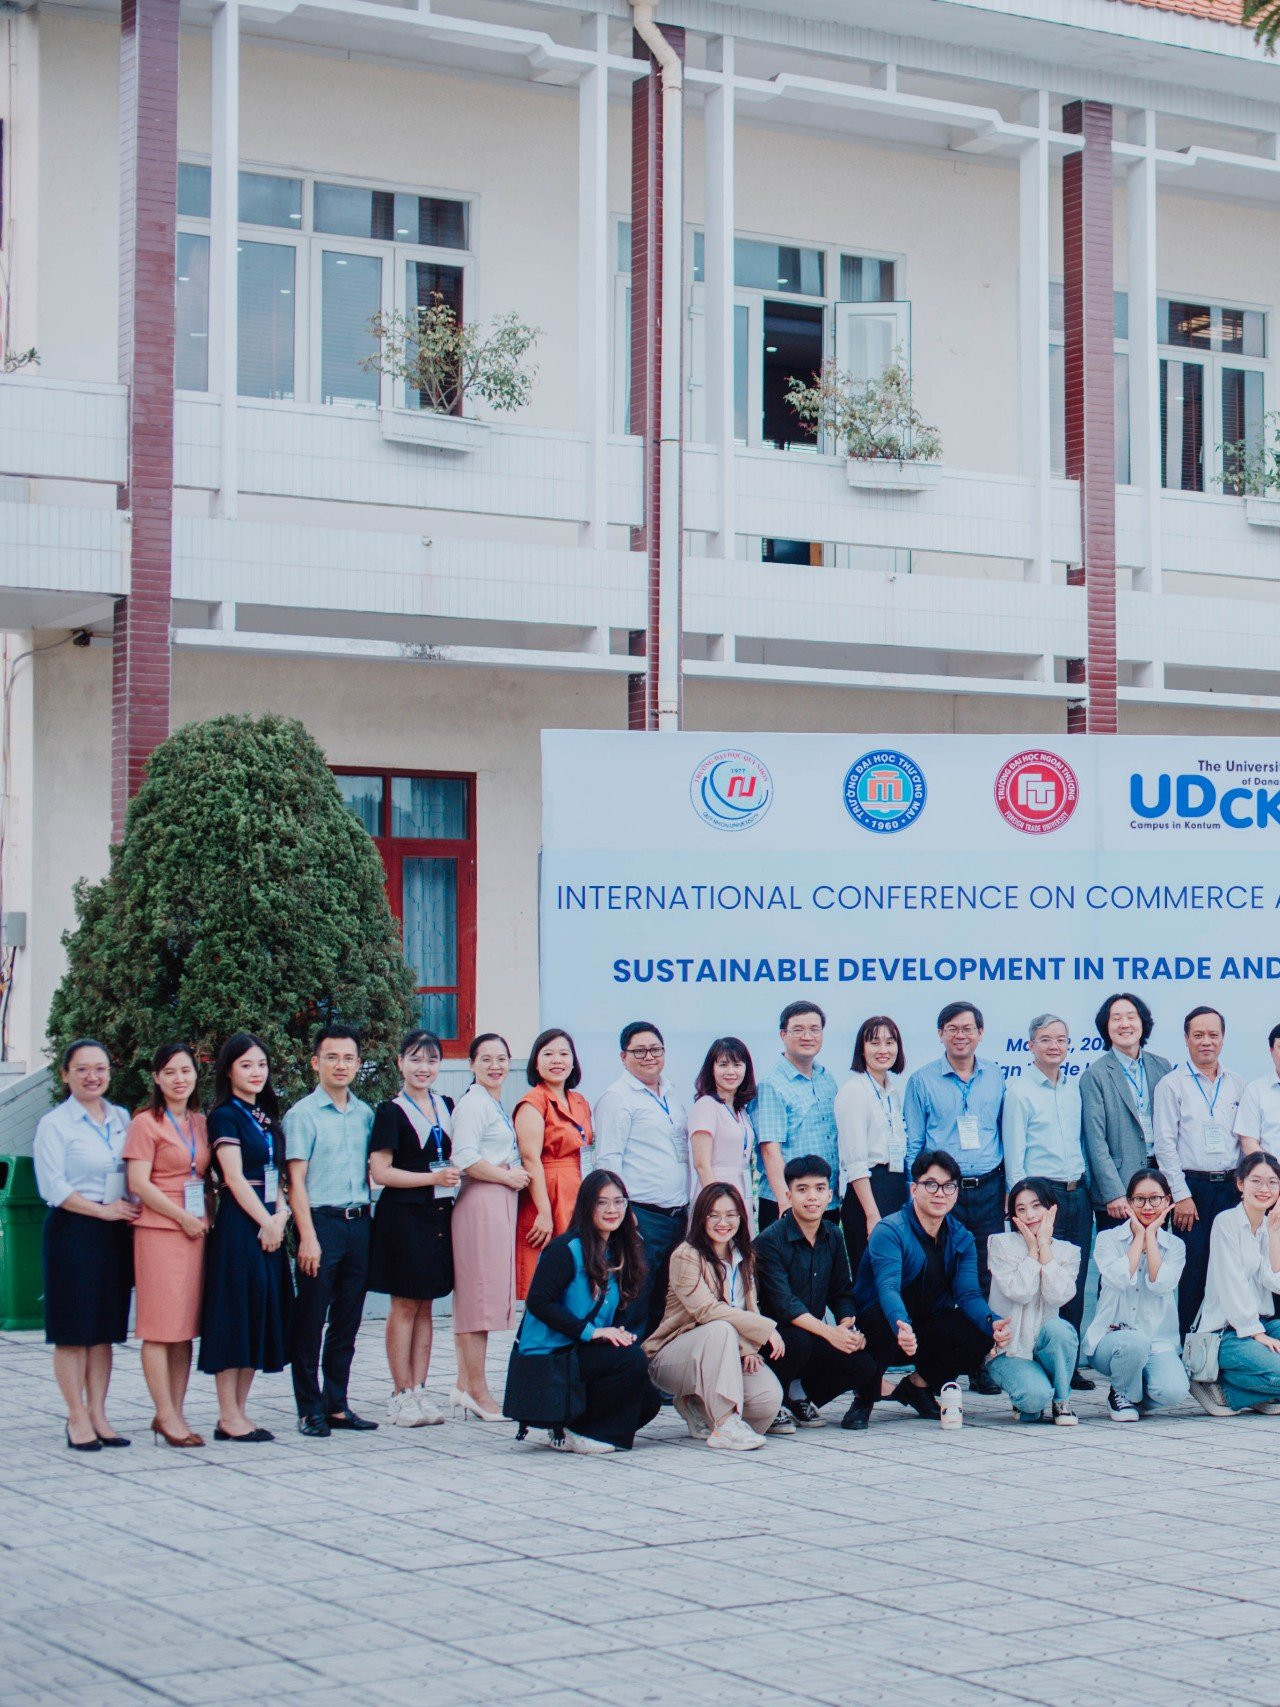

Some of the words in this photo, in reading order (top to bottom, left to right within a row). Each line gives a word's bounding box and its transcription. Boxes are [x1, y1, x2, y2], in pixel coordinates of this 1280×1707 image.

[855, 758, 872, 775] ĐẠI
[873, 753, 896, 764] HỌC
[1198, 760, 1221, 772] The
[898, 757, 923, 799] THƯƠNG
[1242, 777, 1251, 786] of
[846, 774, 864, 820] TRƯỜNG
[905, 800, 921, 820] MẠI
[871, 820, 899, 830] 1960
[1004, 810, 1025, 829] FOREIGN
[1025, 823, 1042, 832] TRADE
[1042, 811, 1069, 831] UNIVERSITY
[1130, 820, 1169, 831] Campus
[1172, 821, 1181, 829] in
[1184, 821, 1221, 829] Kontum
[557, 885, 802, 910] INTERNATIONAL
[813, 885, 1018, 910] CONFERENCE
[1030, 885, 1075, 910] ON
[1086, 885, 1264, 910] COMMERCE
[613, 958, 828, 983] SUSTAINABLE
[838, 957, 1066, 982] DEVELOPMENT
[1074, 957, 1103, 981] IN
[1113, 956, 1211, 981] TRADE
